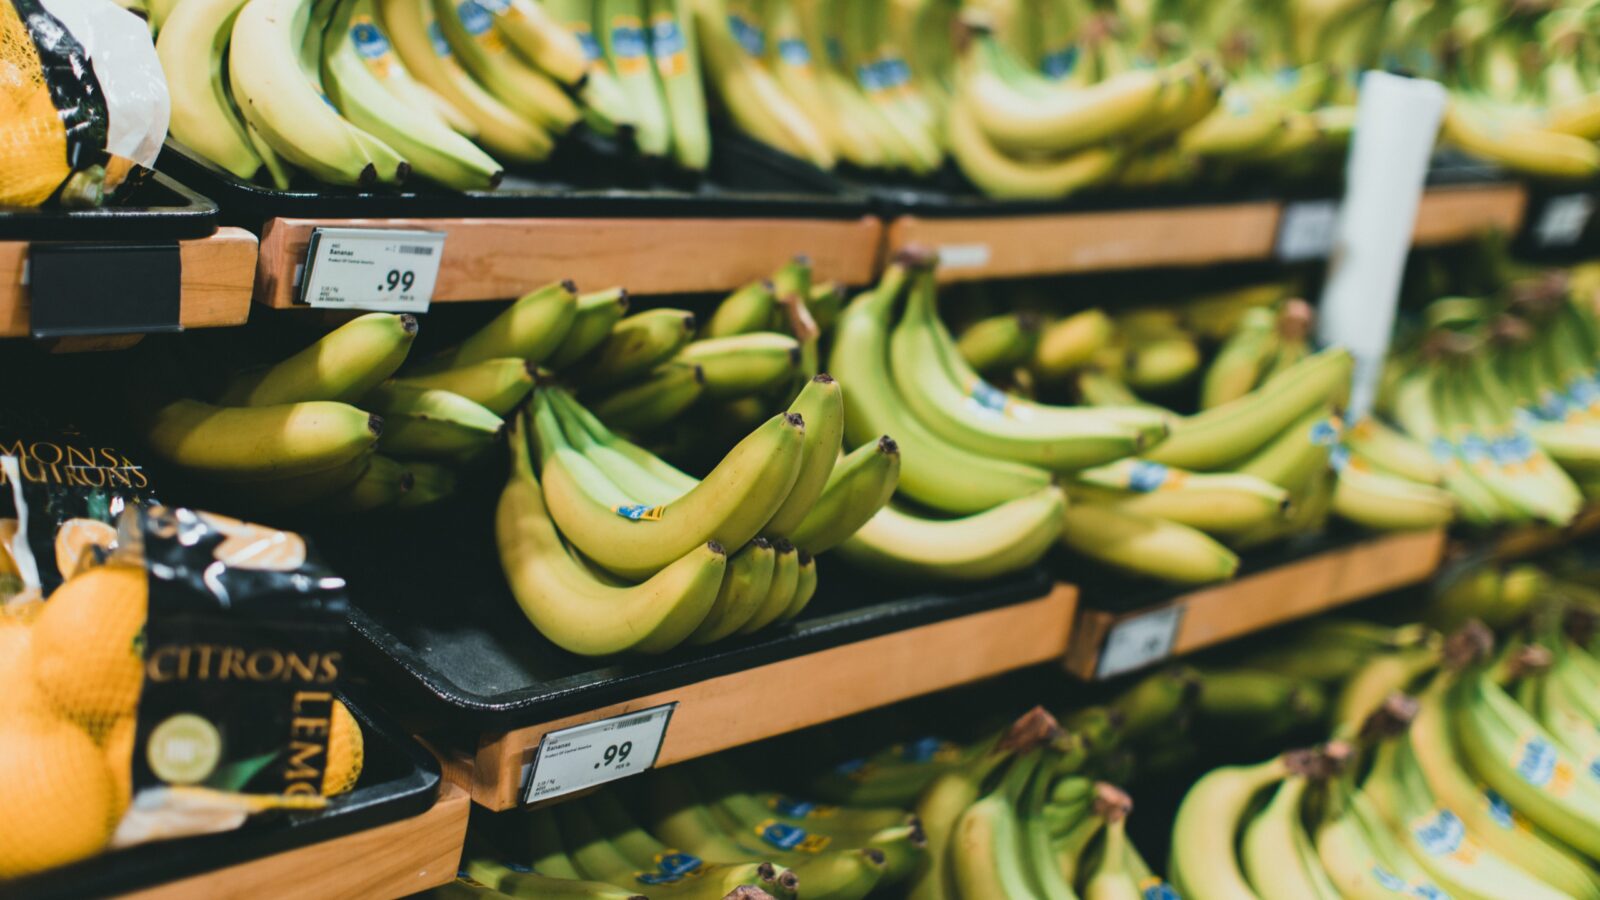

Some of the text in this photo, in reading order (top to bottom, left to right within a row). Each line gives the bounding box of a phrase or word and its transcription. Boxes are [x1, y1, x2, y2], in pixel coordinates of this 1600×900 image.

[377, 269, 415, 292] .99
[147, 644, 342, 683] CITRONS
[546, 742, 571, 752] Bananas
[593, 741, 632, 769] .99
